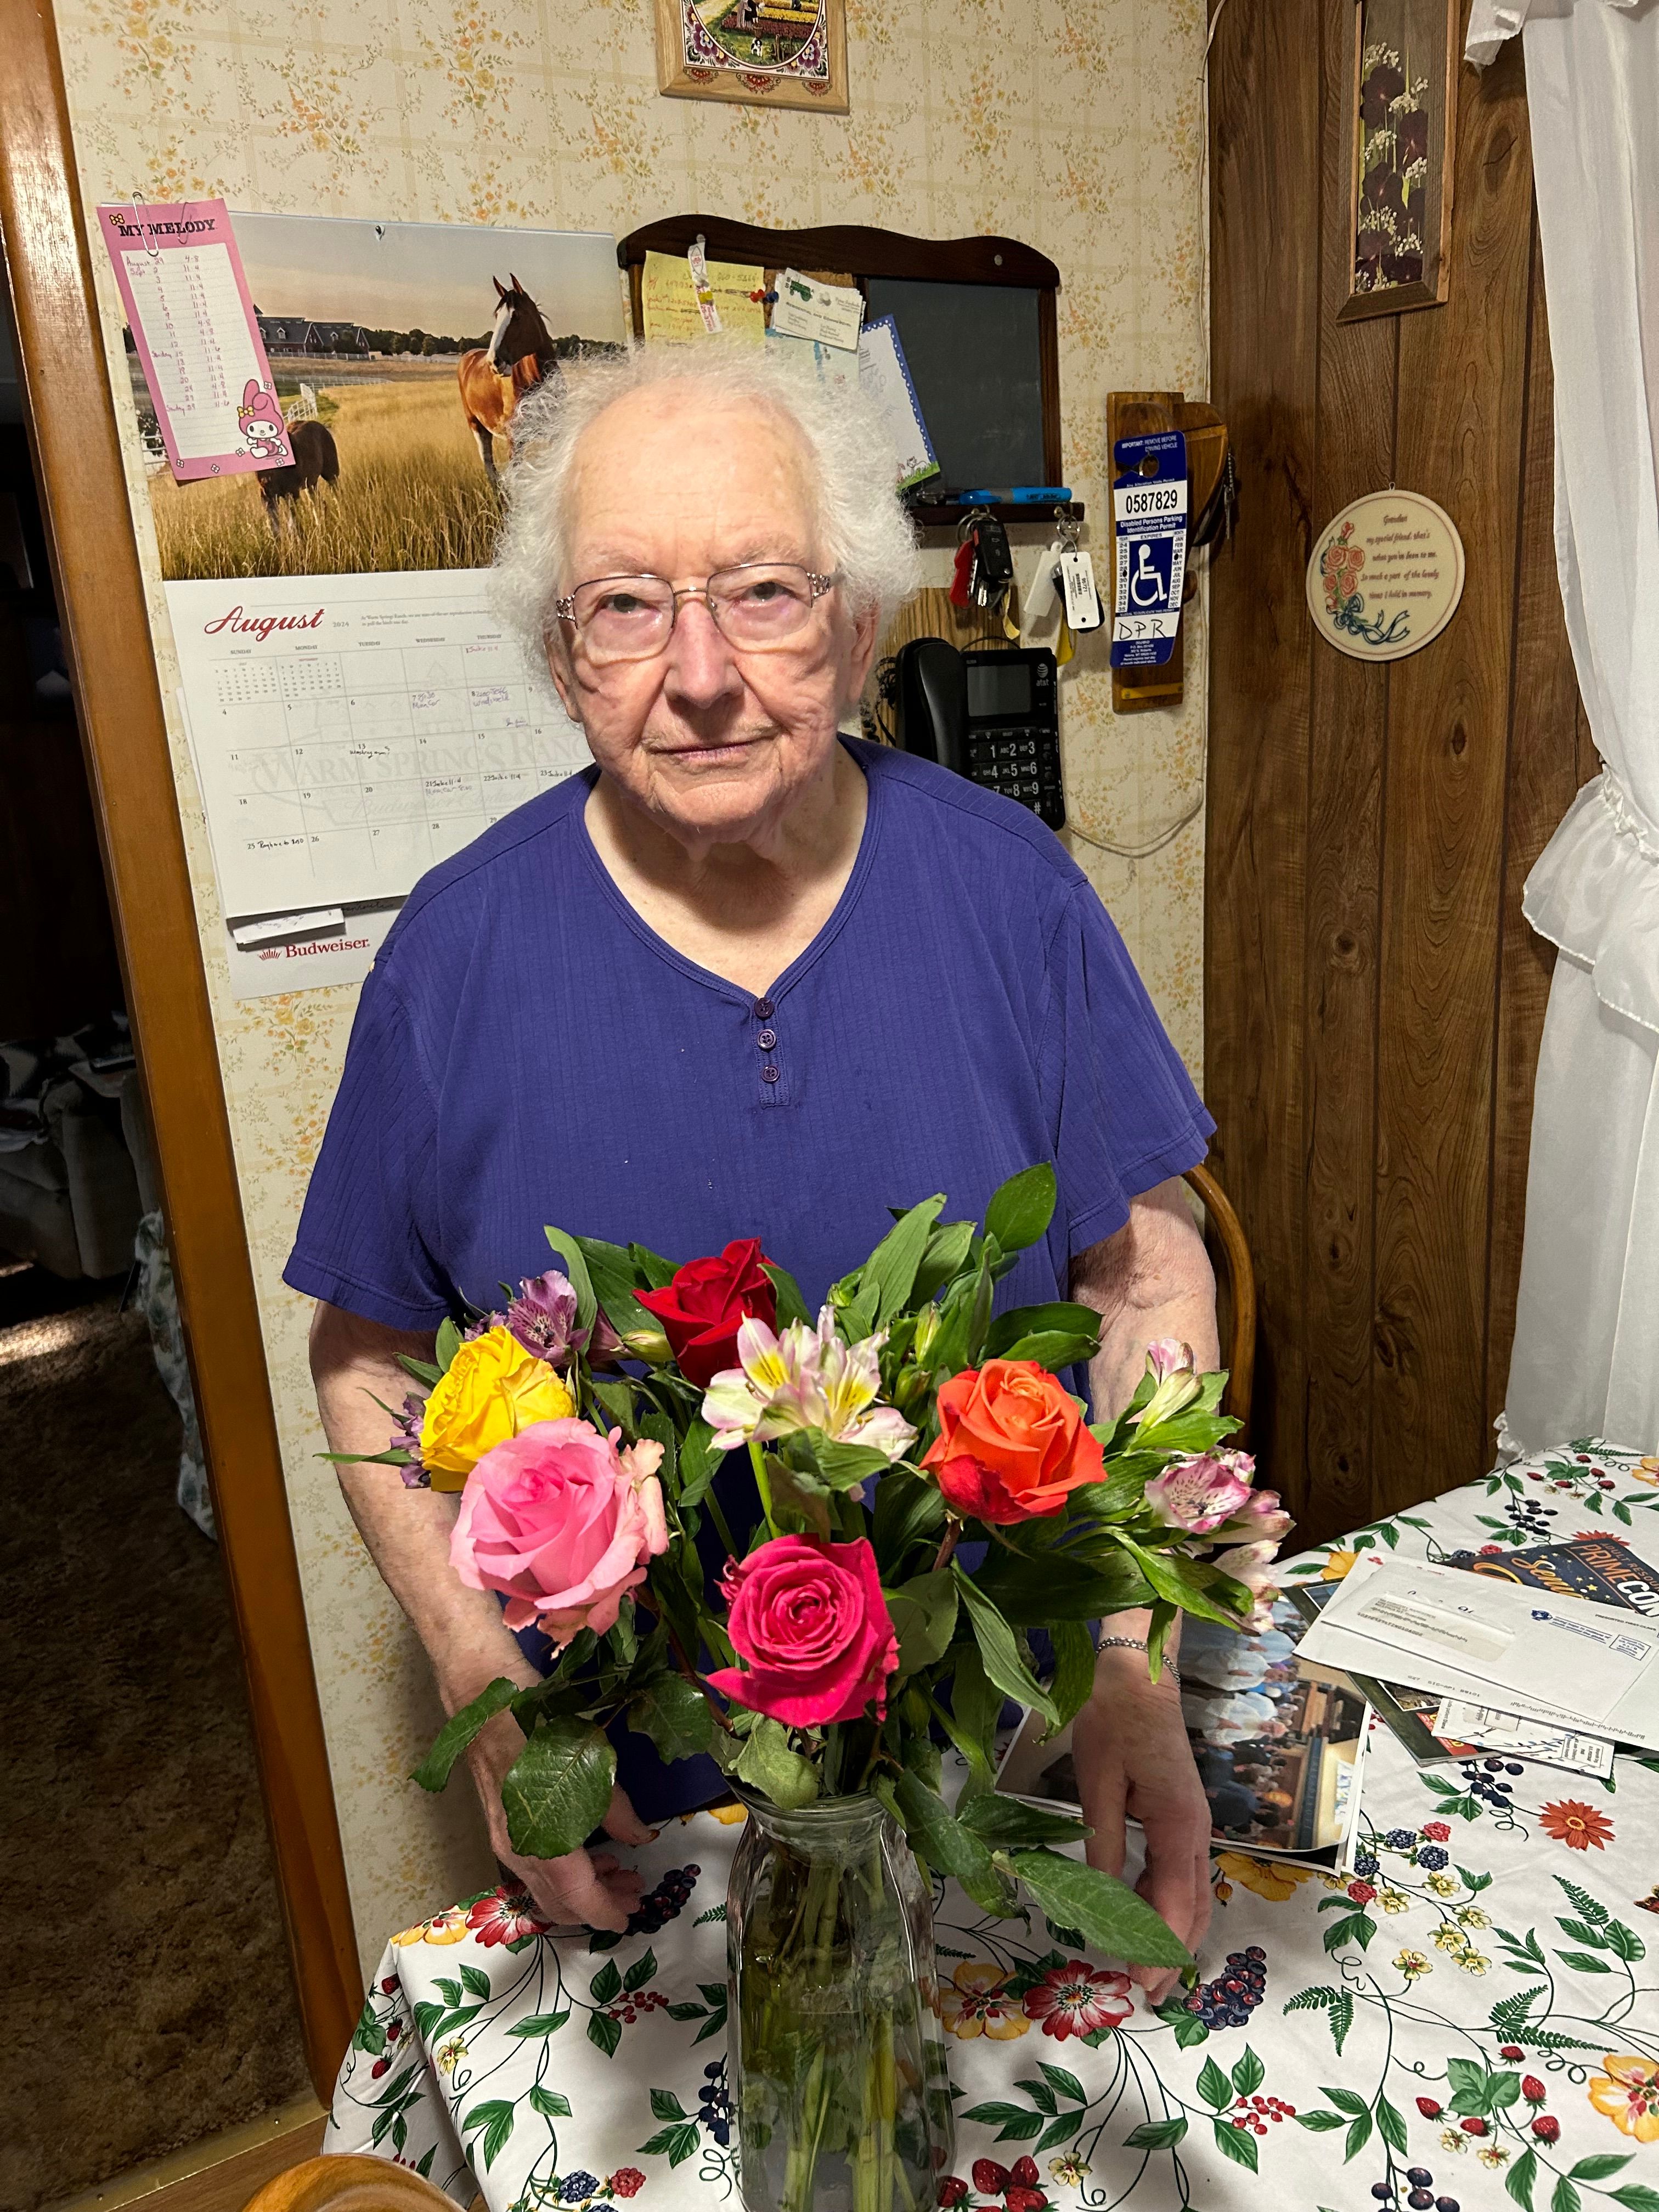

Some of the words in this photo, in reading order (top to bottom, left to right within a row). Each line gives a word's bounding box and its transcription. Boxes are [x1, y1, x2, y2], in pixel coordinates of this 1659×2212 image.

[118, 224, 144, 236] MY
[147, 219, 215, 235] MELODY
[127, 256, 149, 270] August
[1125, 489, 1177, 514] 0587829
[1120, 519, 1142, 528] Disabled
[1143, 517, 1163, 525] Persons
[1127, 525, 1159, 533] Identification
[204, 605, 325, 642] August
[990, 745, 996, 758] 1
[1009, 743, 1017, 757] 2
[1029, 741, 1035, 754] 3
[991, 765, 998, 778] 4
[1011, 764, 1018, 776] 5
[1030, 762, 1037, 775] 6
[1013, 783, 1020, 797] 8
[1032, 782, 1039, 794] 9
[285, 938, 369, 958] Budweiser
[1600, 1543, 1630, 1564] ADULT
